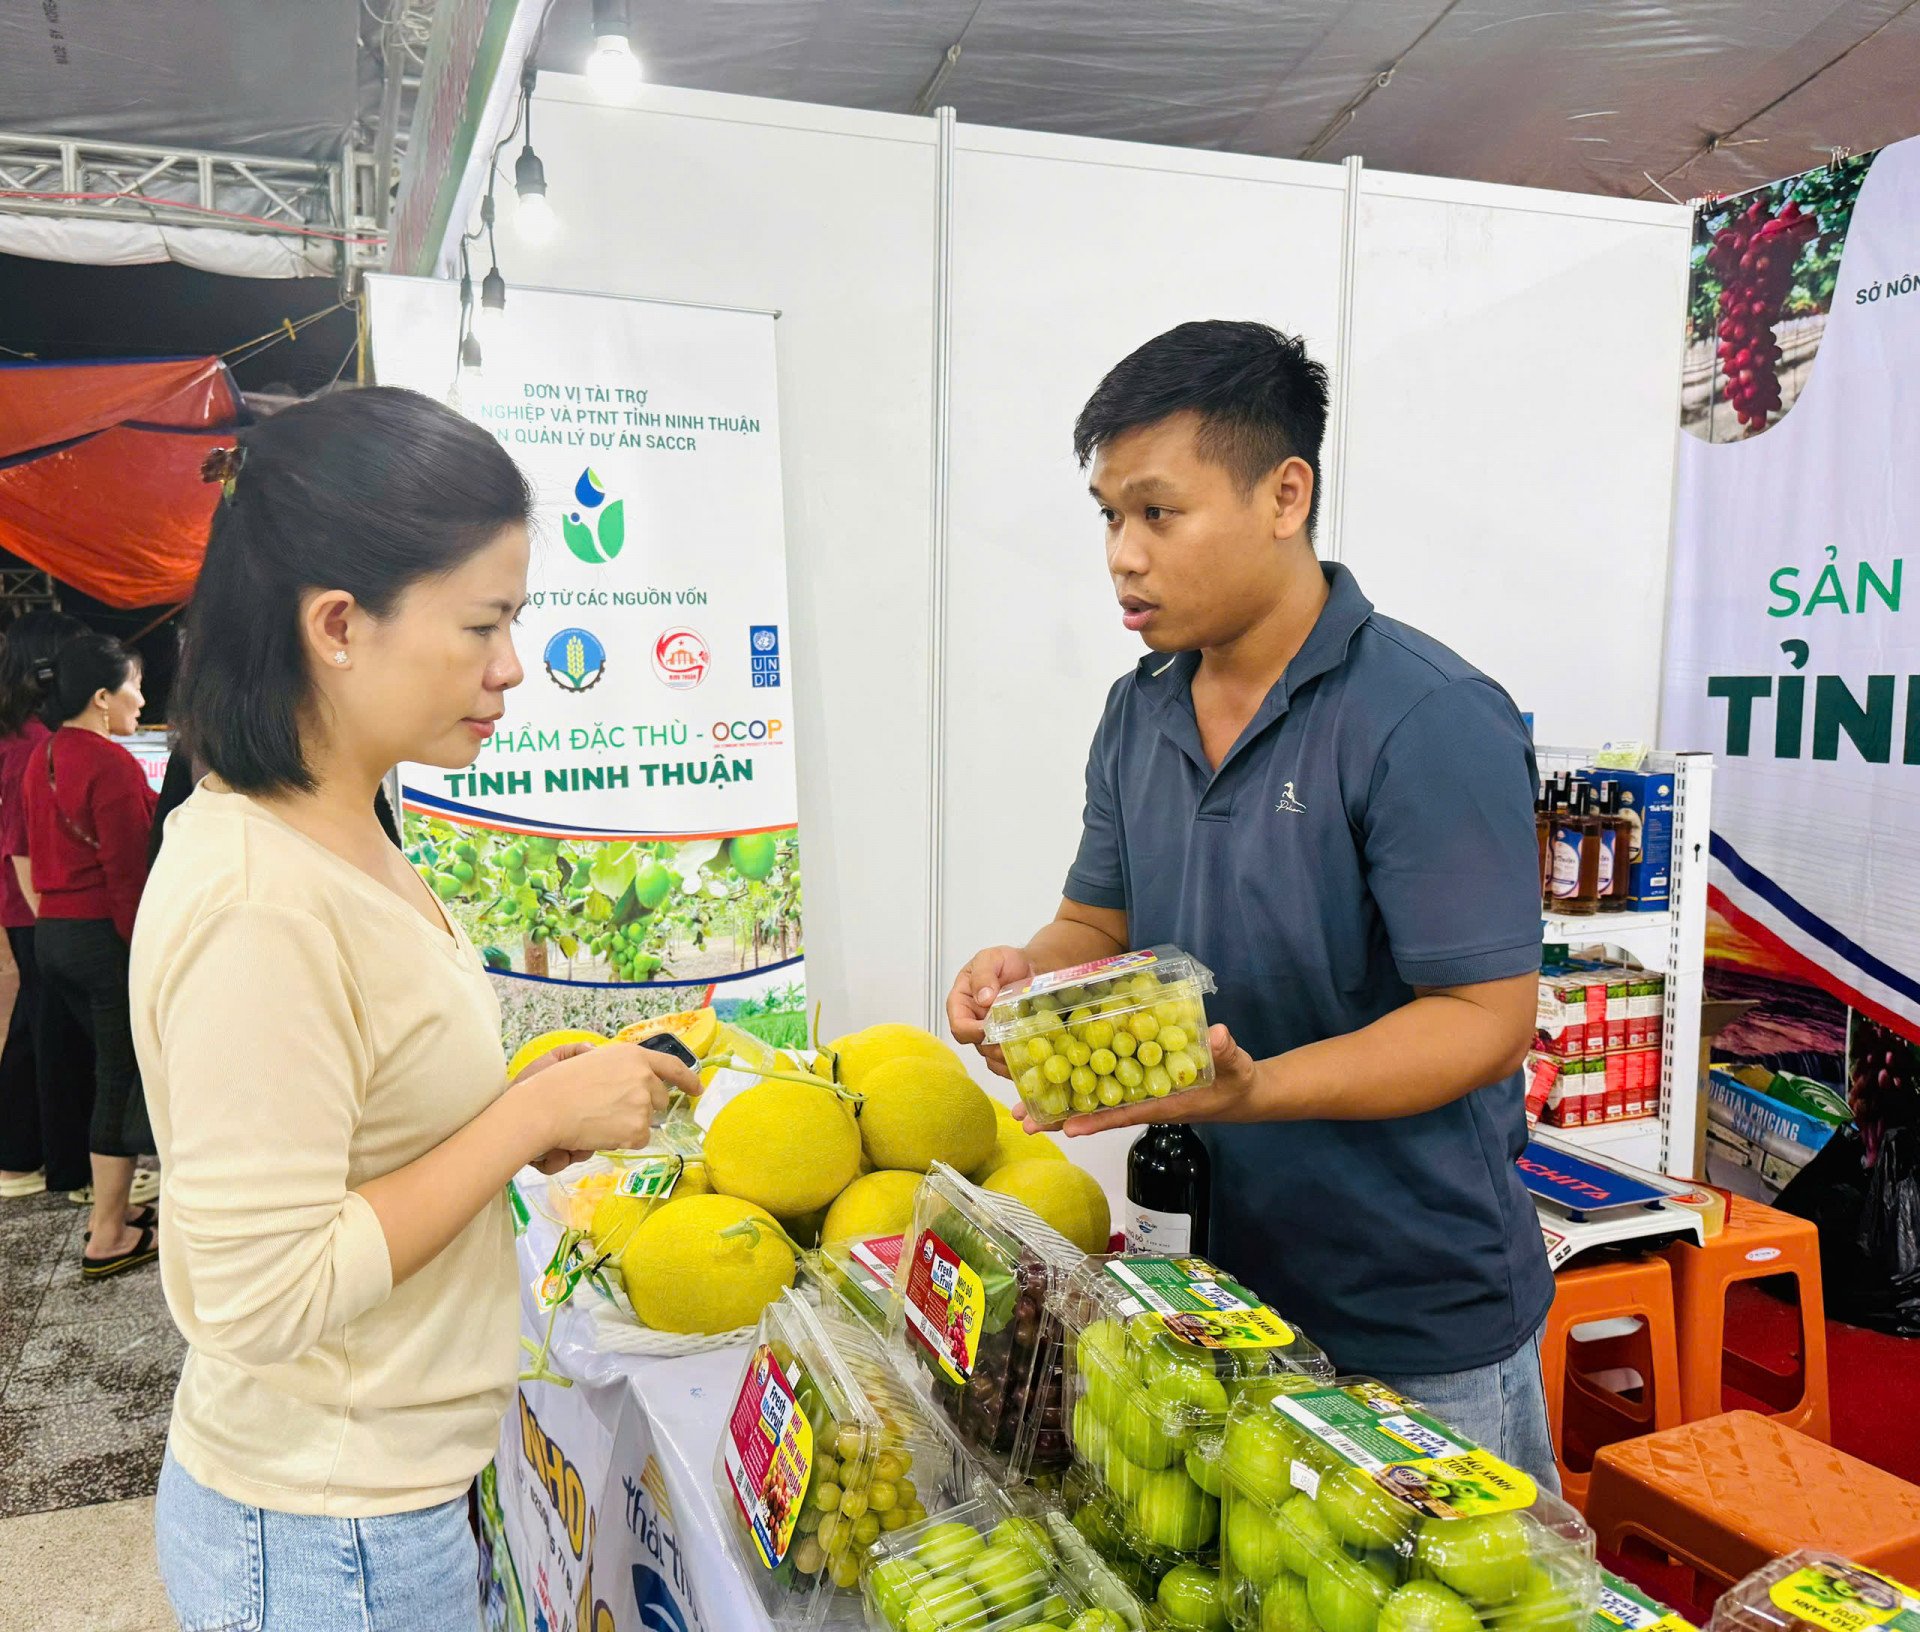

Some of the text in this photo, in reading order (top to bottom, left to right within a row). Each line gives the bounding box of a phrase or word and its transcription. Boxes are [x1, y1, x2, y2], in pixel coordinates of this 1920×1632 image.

[1856, 280, 1882, 305] SỞ
[524, 383, 648, 408] ĐƠN VỊ TÀI TRỢ
[481, 402, 545, 424] NGHIỆP
[551, 404, 572, 423] VÀ
[577, 409, 620, 425] PTNT
[624, 407, 661, 427] TỈNH
[666, 414, 704, 429] NINH
[708, 414, 760, 436] THUẬN
[496, 425, 697, 451] N QUẢN LÝ DỰ ÁN SACCR
[1766, 544, 1903, 619] SẢN
[526, 586, 708, 609] RỢ TỪ CÁC NGUỒN VỐN
[569, 722, 625, 755] ĐẶC
[633, 719, 688, 748] THÙ
[712, 719, 783, 742] OCOP
[444, 753, 753, 798] TỈNH NINH THUẬN
[1750, 1101, 1800, 1142] PRICING
[938, 1259, 953, 1279] Fresh
[939, 1273, 953, 1292] Fruit
[770, 1385, 786, 1416] Fresh
[768, 1405, 784, 1434] Fruit
[791, 1410, 803, 1435] NHO
[1402, 1432, 1444, 1454] Fruit
[1403, 1422, 1449, 1448] Fresh
[1458, 1455, 1517, 1493] TÁO XANH
[1791, 1597, 1830, 1619] XANH
